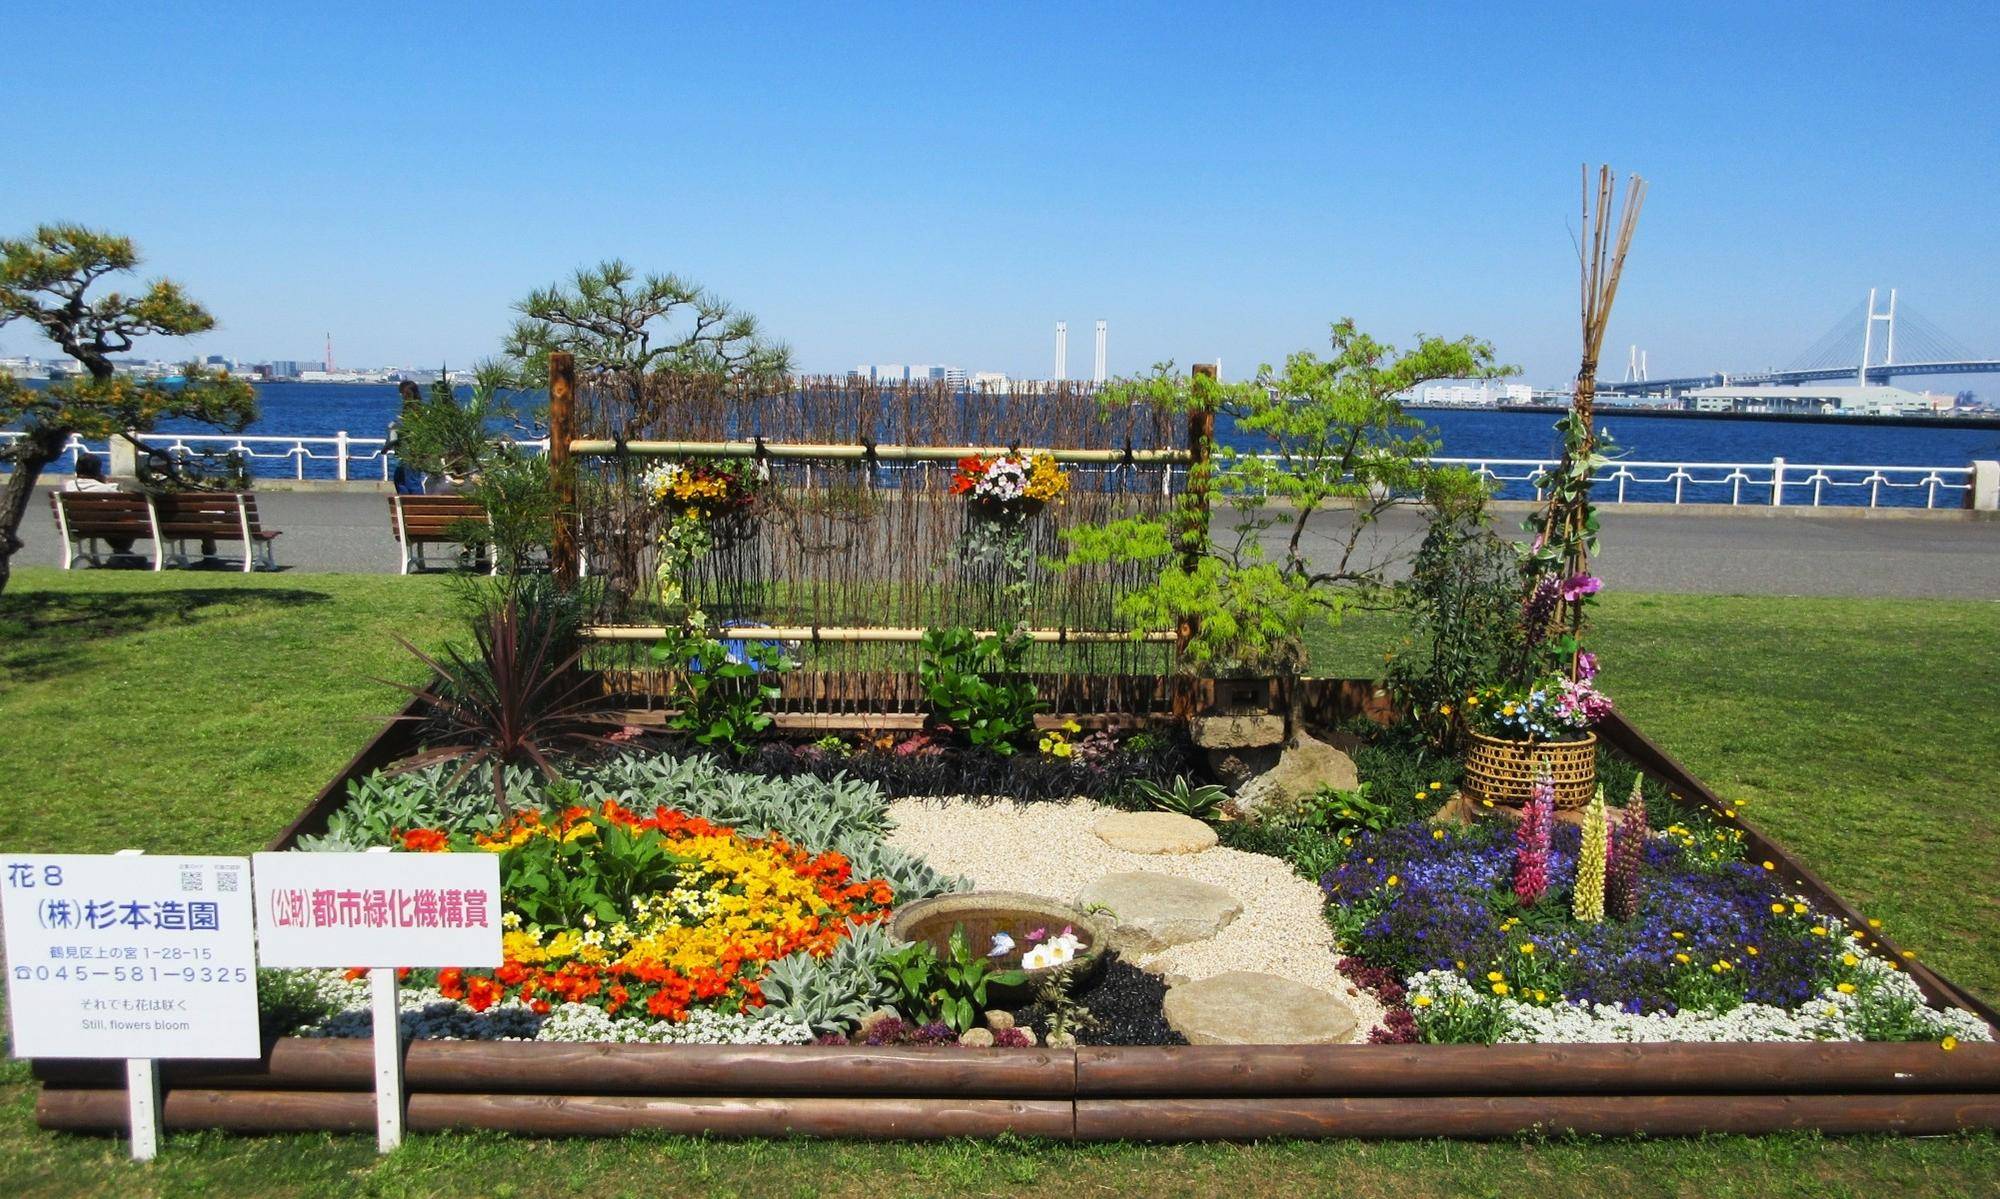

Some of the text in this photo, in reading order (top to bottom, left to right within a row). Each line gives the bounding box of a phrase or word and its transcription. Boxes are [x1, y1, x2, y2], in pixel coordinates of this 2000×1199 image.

[8, 863, 63, 888] 花8
[38, 899, 219, 931] (株)杉本造園
[271, 888, 488, 928] (公財)都市緑化機構賞
[80, 999, 188, 1012] それでも花は咲く
[82, 1019, 190, 1031] Still, flowers bloom
